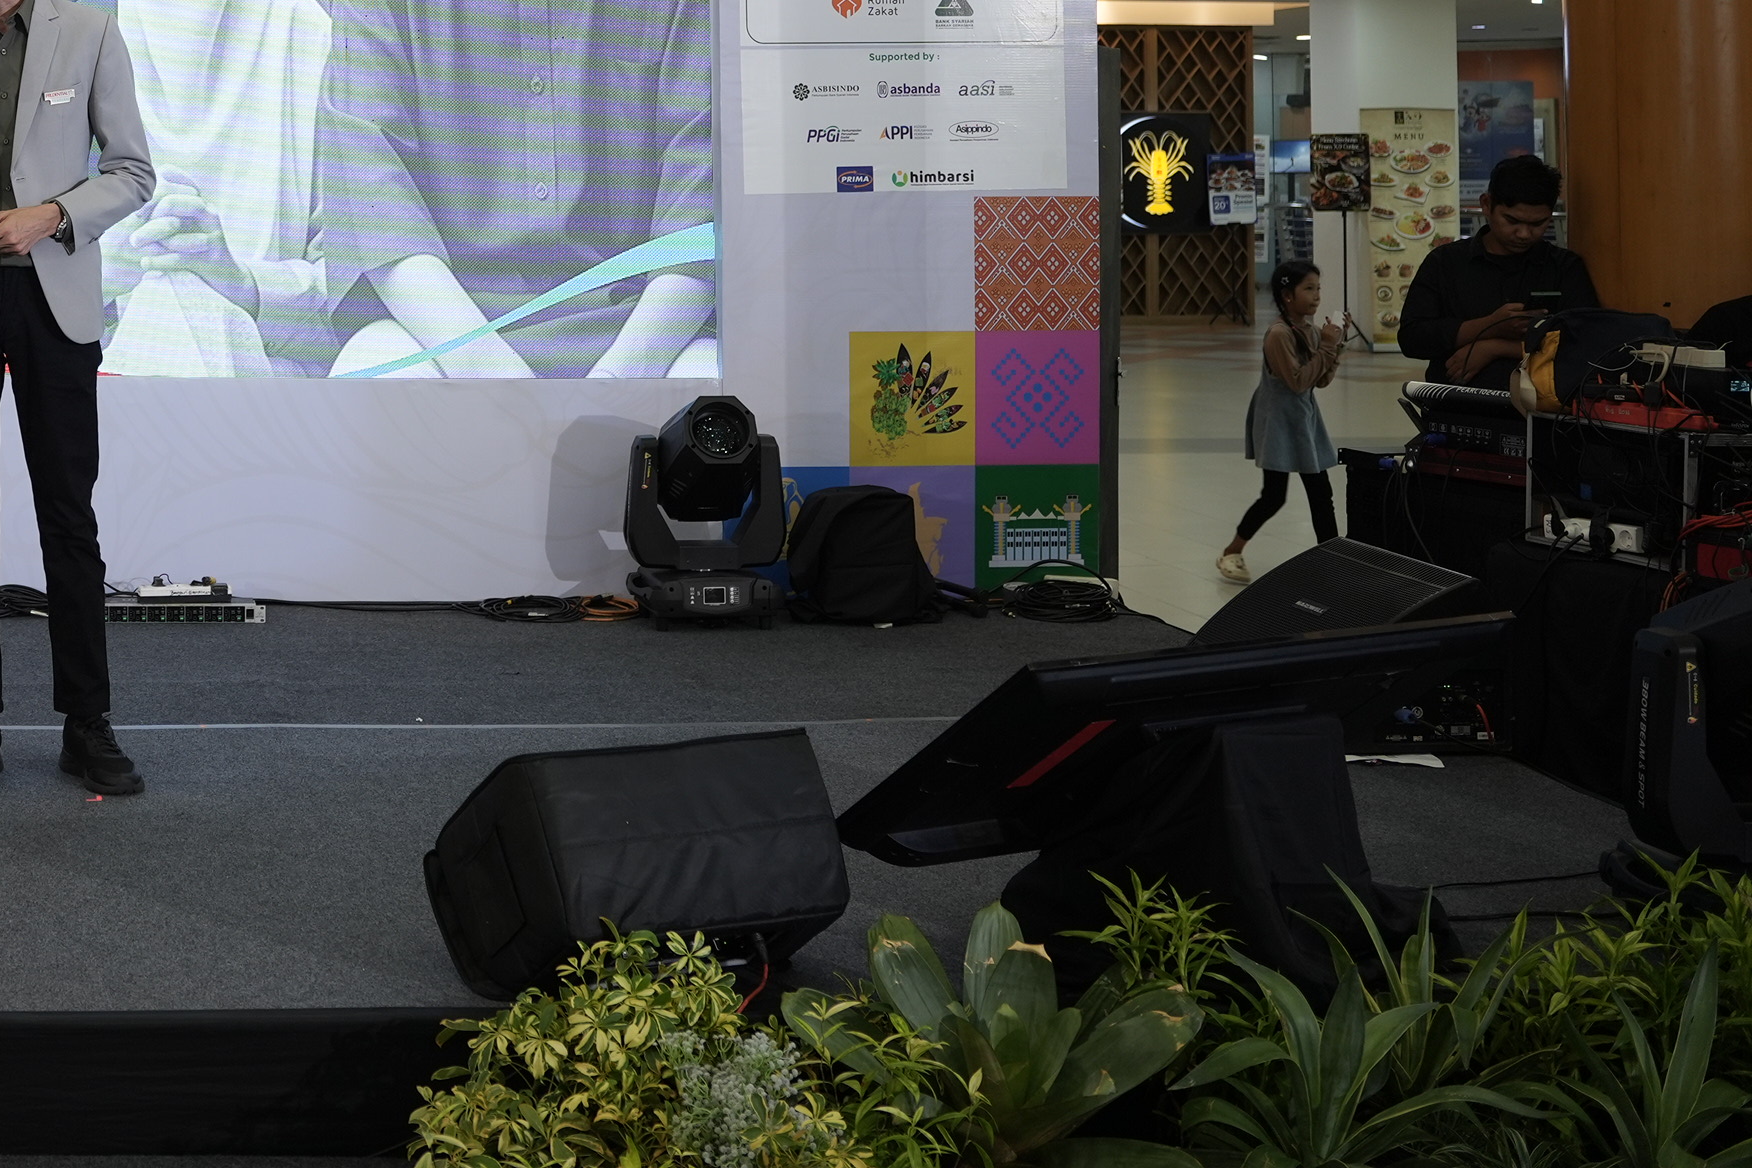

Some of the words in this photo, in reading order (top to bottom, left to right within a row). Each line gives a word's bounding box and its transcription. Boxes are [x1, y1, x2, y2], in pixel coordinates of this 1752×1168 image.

[867, 6, 899, 16] Zakat
[869, 51, 919, 62] Supported
[922, 51, 935, 63] by
[812, 84, 860, 93] ASBISINDO
[890, 82, 941, 95] asbanda
[959, 80, 996, 97] aasi
[955, 123, 992, 135] Asippindo
[1394, 133, 1425, 141] MENU
[841, 175, 870, 183] PRIMA
[910, 169, 975, 183] himbarsi
[1639, 722, 1647, 760] BEAM
